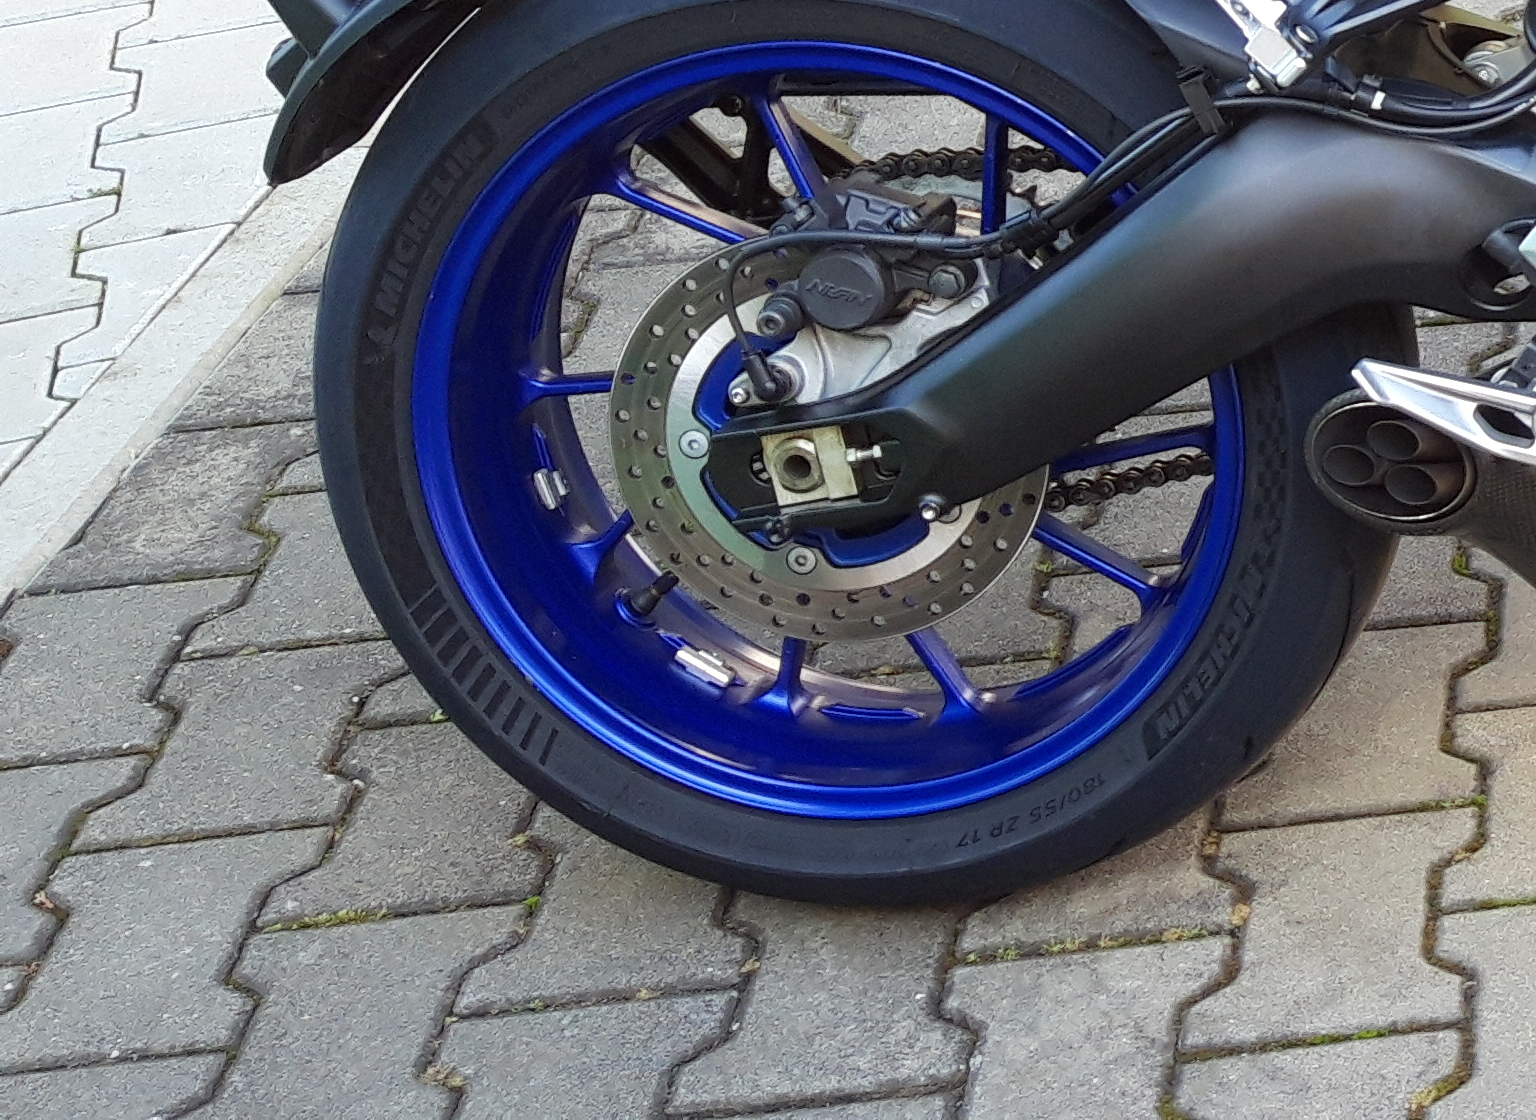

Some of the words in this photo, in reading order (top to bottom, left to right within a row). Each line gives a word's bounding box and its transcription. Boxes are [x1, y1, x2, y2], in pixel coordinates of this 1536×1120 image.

[373, 134, 485, 314] MICHELIN
[1030, 773, 1105, 824] 180/55
[956, 829, 981, 847] 17
